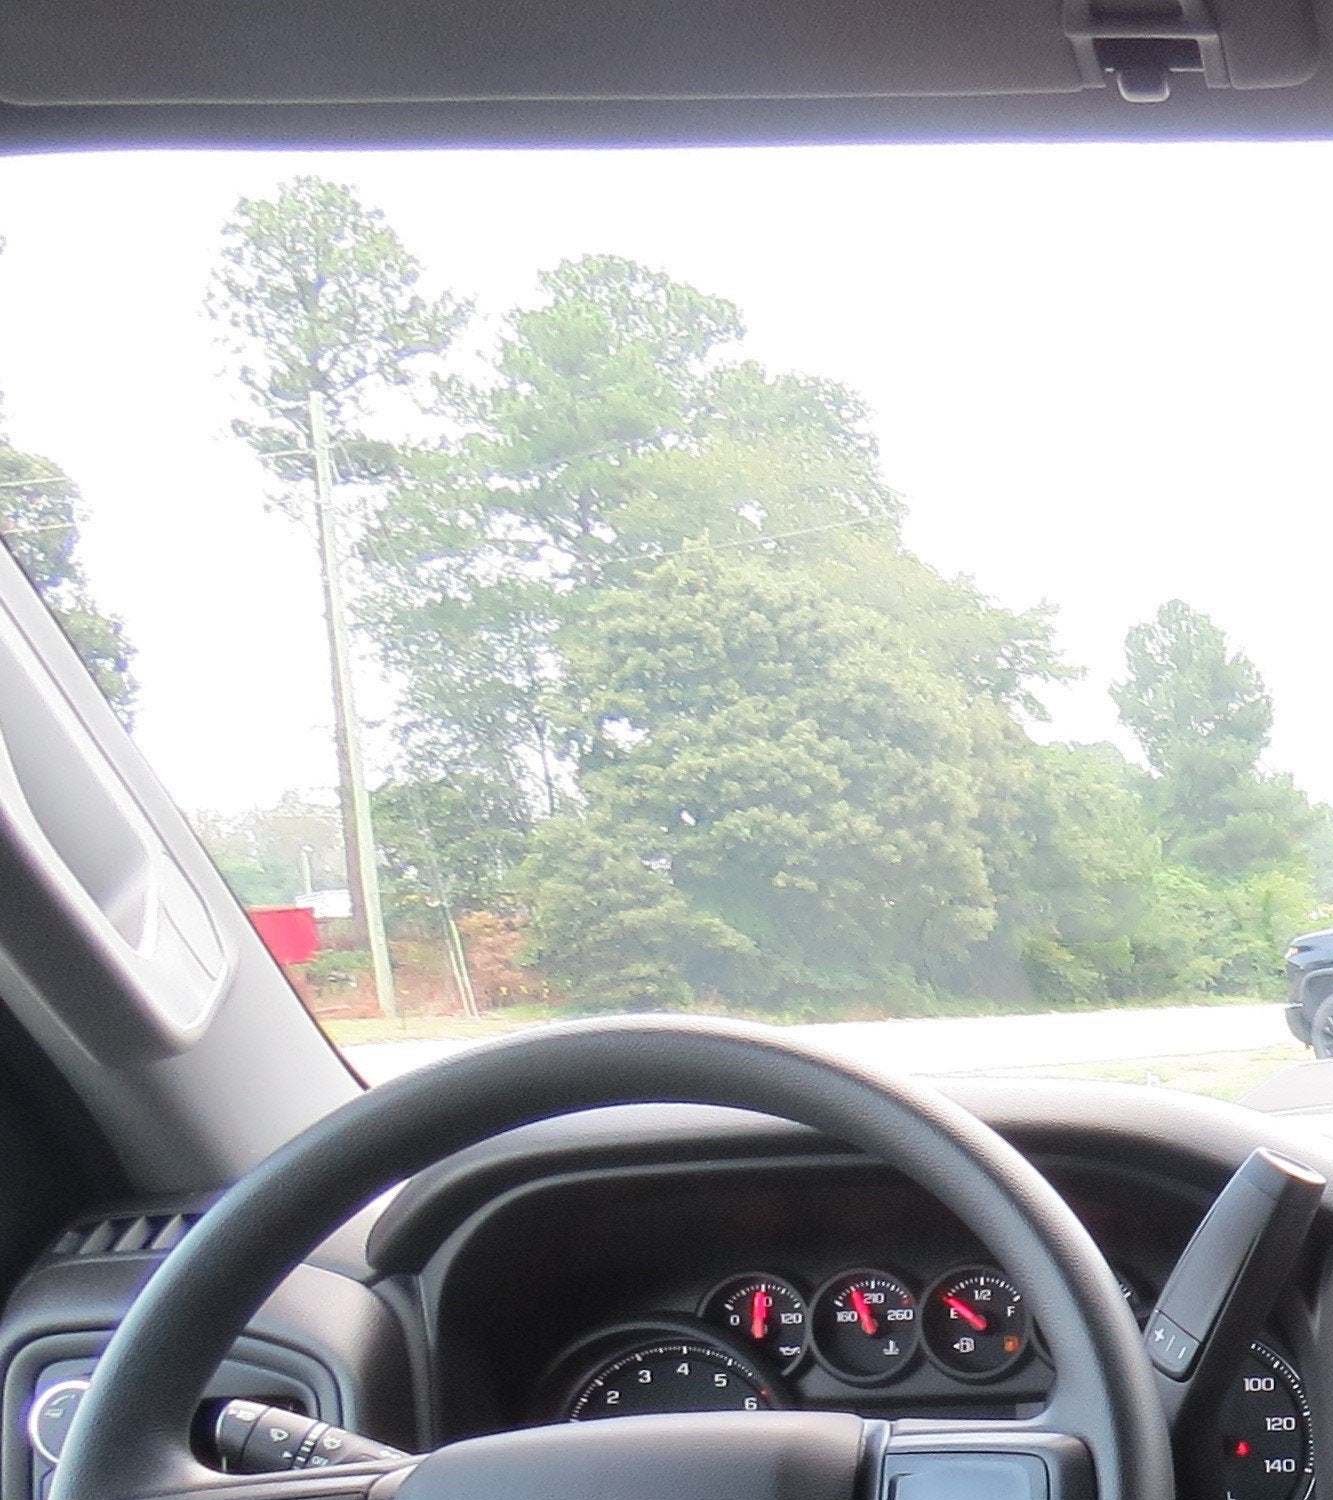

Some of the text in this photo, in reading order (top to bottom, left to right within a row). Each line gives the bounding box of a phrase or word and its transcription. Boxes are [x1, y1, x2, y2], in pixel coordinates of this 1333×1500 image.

[863, 1292, 885, 1305] 210
[974, 1289, 992, 1301] 1/2
[835, 1310, 859, 1324] 160
[886, 1309, 914, 1322] 260
[949, 1307, 959, 1320] E
[1006, 1305, 1017, 1318] F
[729, 1314, 741, 1327] 0
[779, 1313, 803, 1325] 120
[676, 1362, 690, 1376] 4
[638, 1369, 652, 1384] 3
[713, 1373, 728, 1388] 5
[1243, 1377, 1275, 1392] 100
[606, 1390, 620, 1405] 2
[744, 1397, 758, 1411] 6
[1265, 1416, 1296, 1431] 120
[1264, 1458, 1296, 1473] 140
